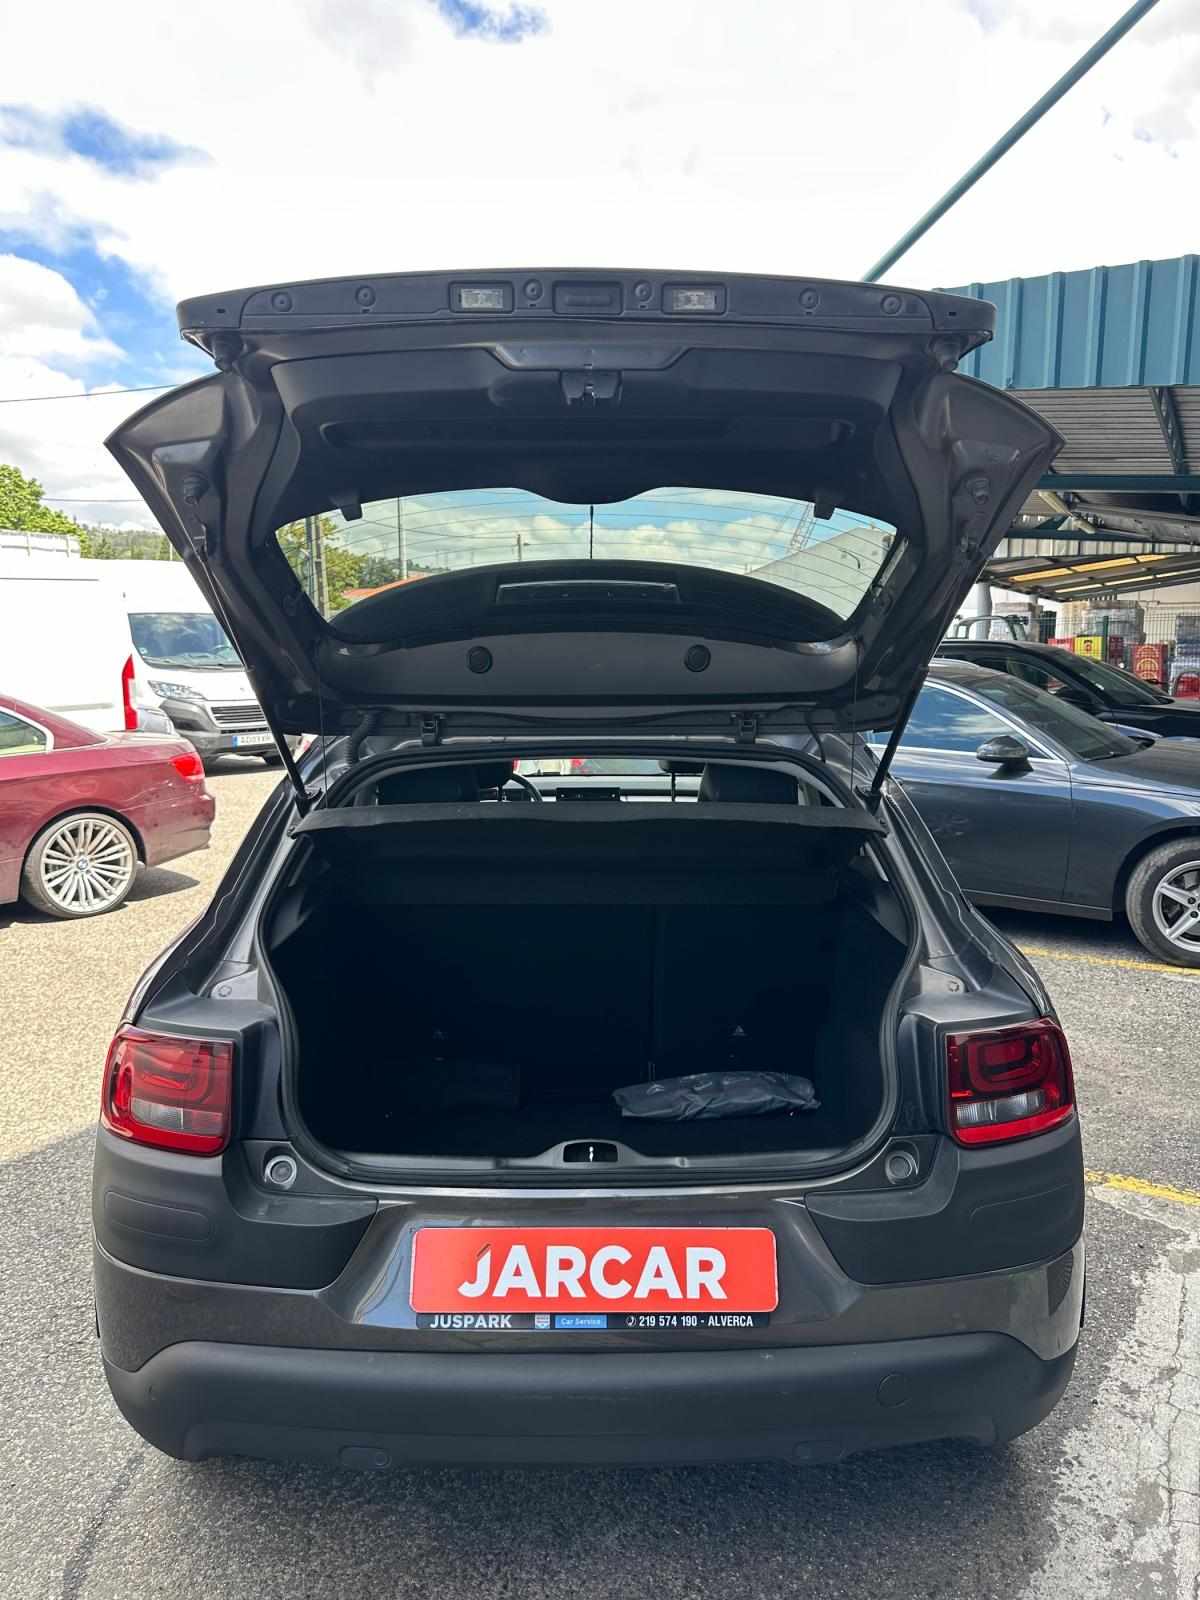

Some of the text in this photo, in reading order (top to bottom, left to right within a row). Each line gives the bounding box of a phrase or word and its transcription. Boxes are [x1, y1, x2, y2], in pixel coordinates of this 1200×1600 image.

[457, 1243, 728, 1299] JARCAR
[430, 1314, 512, 1328] JUSPARK
[560, 1317, 574, 1326] Car
[575, 1317, 601, 1326] Service
[639, 1315, 656, 1327] 219
[659, 1315, 677, 1327] 574
[681, 1315, 698, 1327] 190
[708, 1315, 754, 1327] ALVERCA
